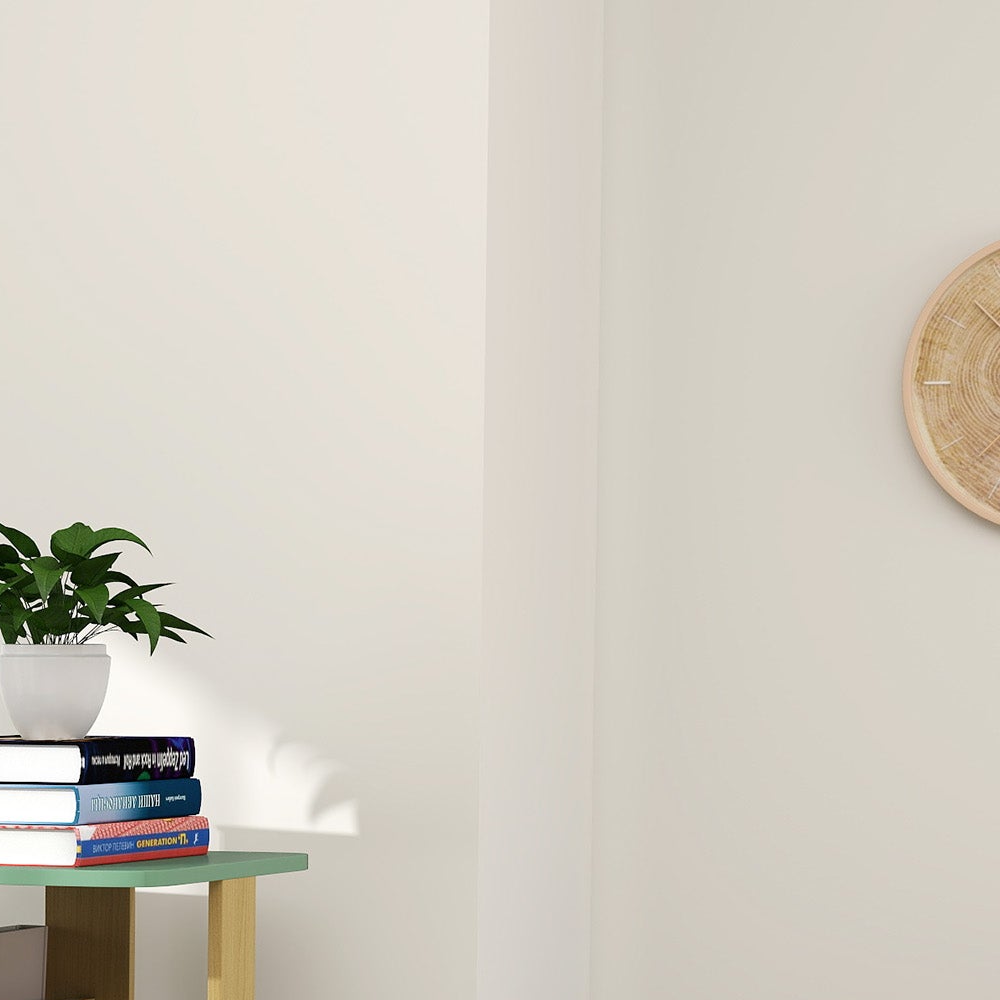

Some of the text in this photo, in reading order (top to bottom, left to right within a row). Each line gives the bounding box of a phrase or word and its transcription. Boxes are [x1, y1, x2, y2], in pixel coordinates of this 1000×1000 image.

[141, 752, 152, 769] Rock
[151, 752, 156, 768] in
[157, 747, 179, 772] Zeppelin
[179, 750, 190, 770] Led
[92, 842, 134, 854] ВИКТОР ПЕЛЕВИН
[136, 837, 177, 849] GENERATION
